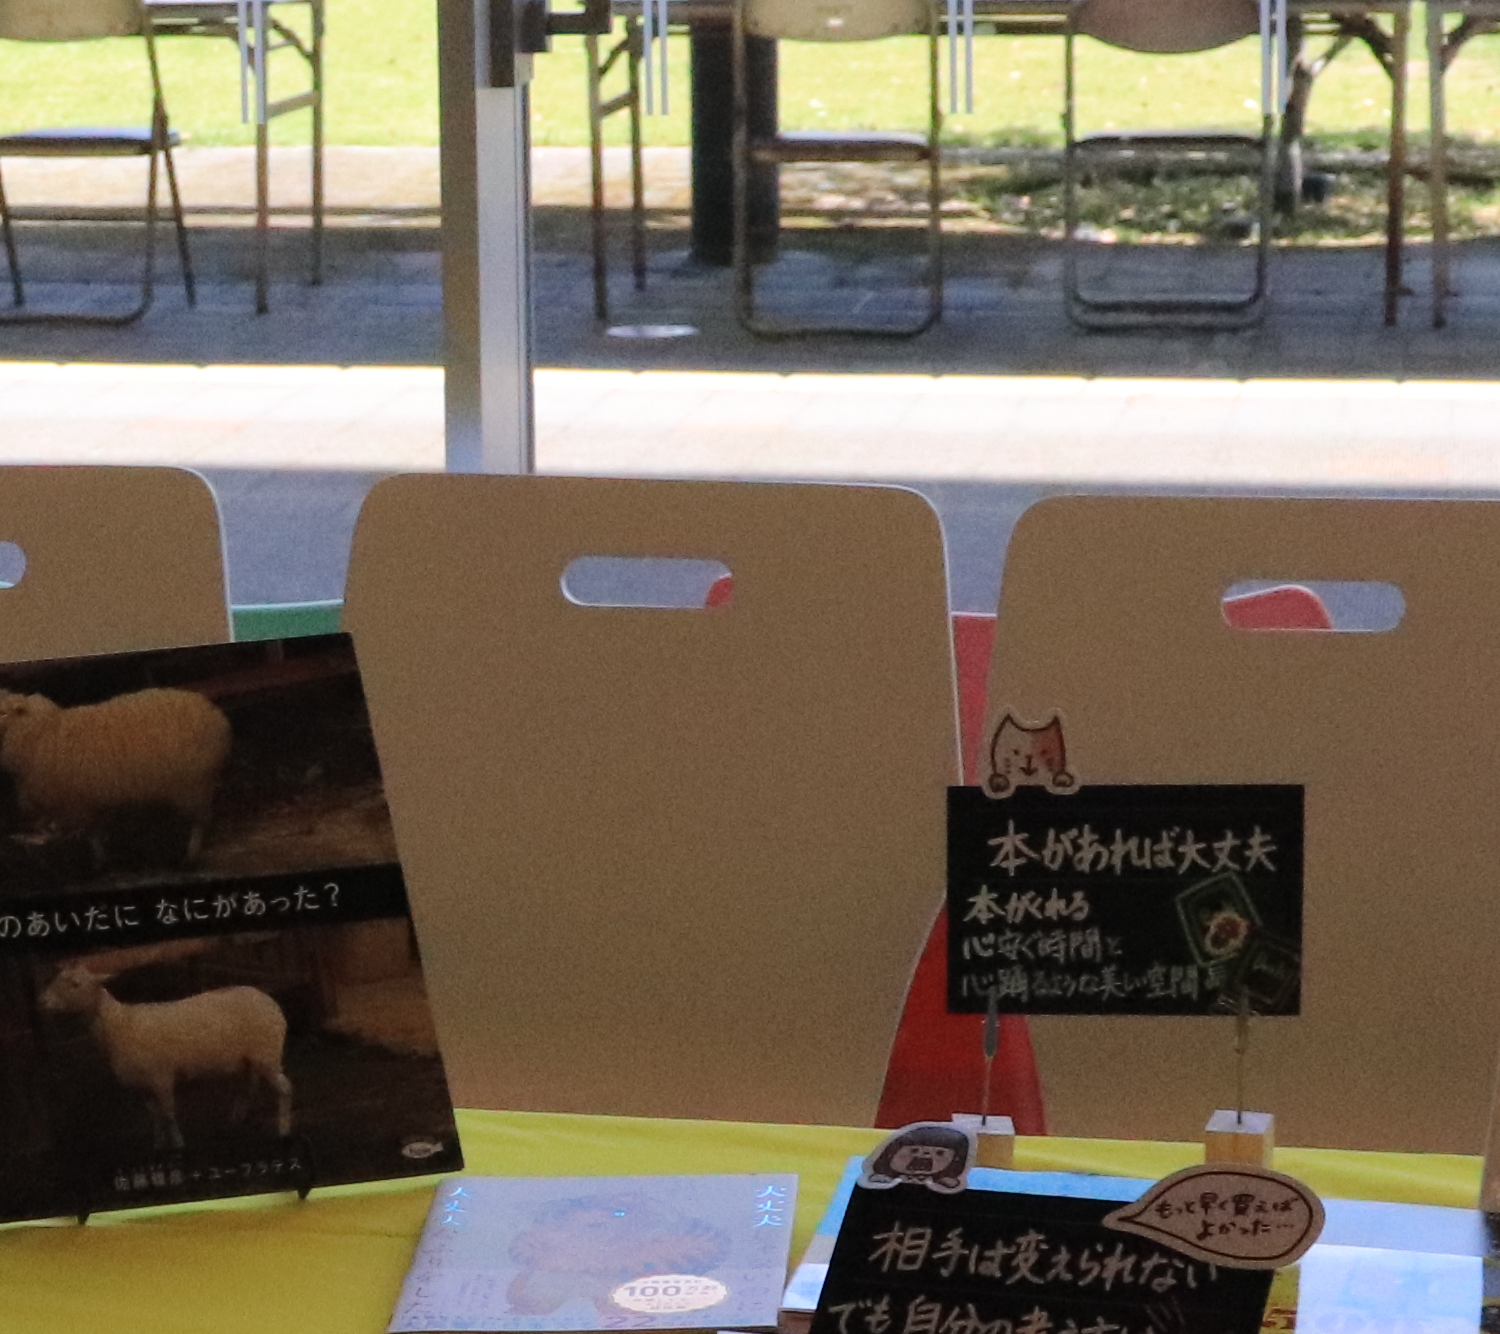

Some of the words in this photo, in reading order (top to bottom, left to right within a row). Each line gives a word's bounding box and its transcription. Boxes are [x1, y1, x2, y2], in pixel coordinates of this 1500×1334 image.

[987, 818, 1280, 877] 本があれば大丈夫
[868, 1225, 1219, 1292] 相手は変えられない
